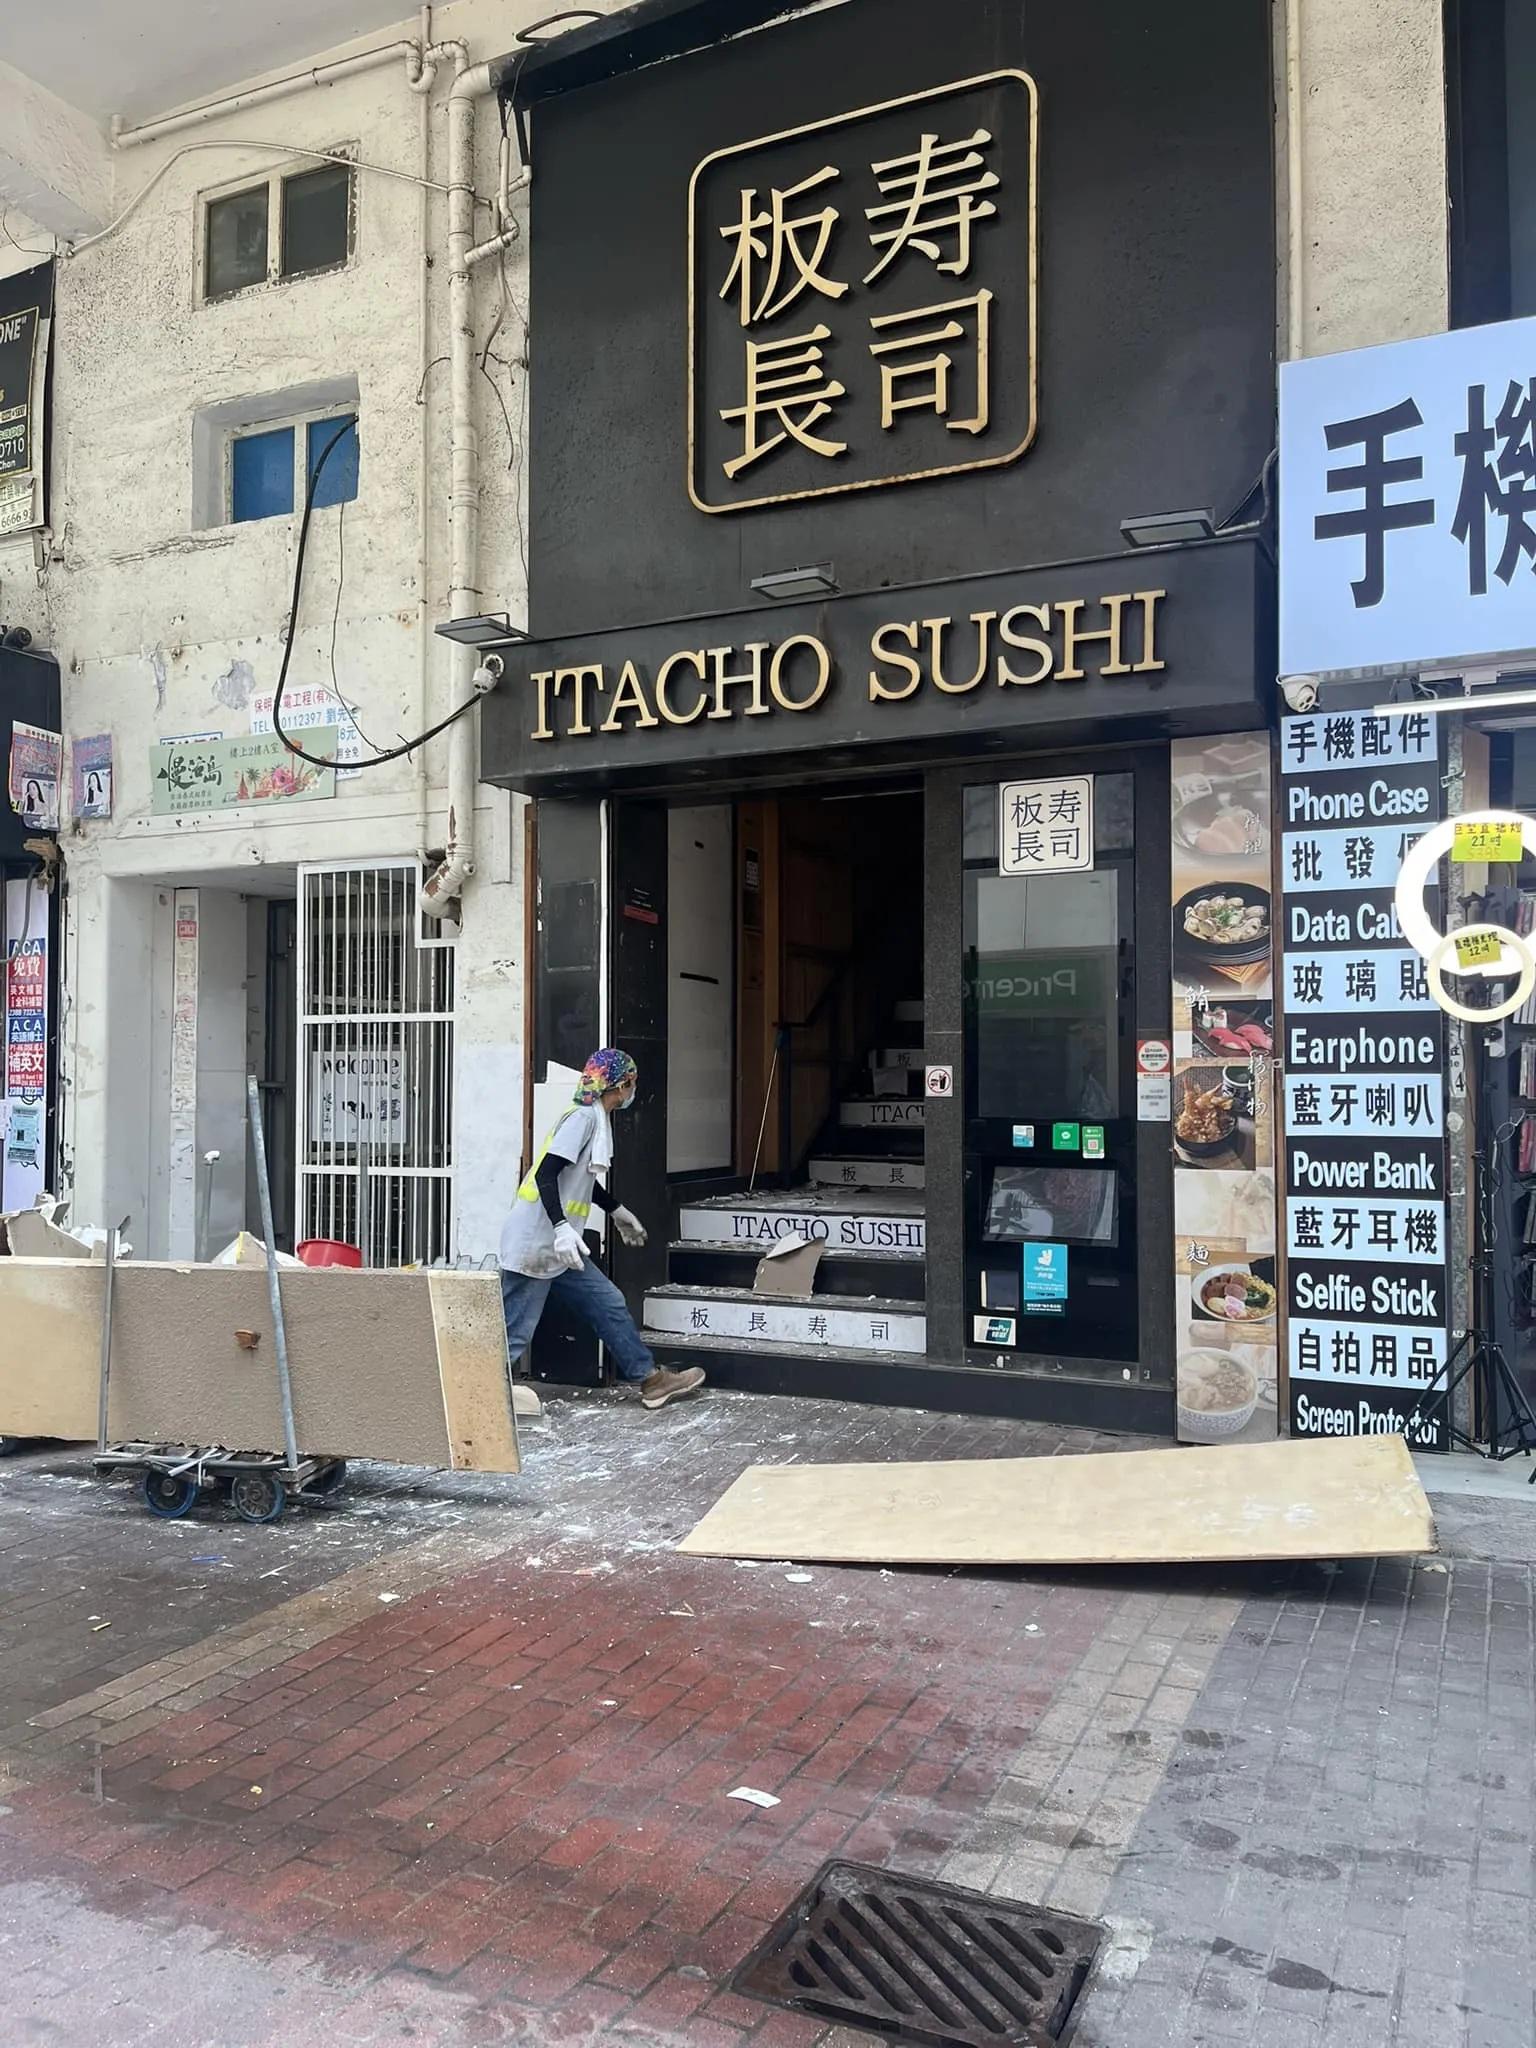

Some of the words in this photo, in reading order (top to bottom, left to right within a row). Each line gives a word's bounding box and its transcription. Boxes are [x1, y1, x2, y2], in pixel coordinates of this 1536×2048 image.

[530, 633, 832, 741] ITACHO
[868, 588, 1168, 703] SUSHI
[1287, 712, 1431, 764] 手機配件
[1288, 786, 1365, 822] Phone
[1369, 780, 1430, 817] Case
[1291, 906, 1351, 943] Data
[1356, 903, 1410, 941] Cab
[13, 957, 41, 977] 免費
[1293, 957, 1430, 1004] 玻璃貼
[12, 1019, 42, 1032] ACA
[323, 1054, 400, 1075] welcome
[1290, 1027, 1435, 1073] Earphone
[1292, 1083, 1435, 1127] 藍牙喇叭
[1293, 1150, 1369, 1188] Power
[1373, 1151, 1436, 1190] Bank
[840, 1220, 924, 1247] SUSHI
[1293, 1206, 1438, 1254] 藍牙耳機
[1295, 1272, 1367, 1313] Selfie
[1371, 1276, 1438, 1317] Stick
[1298, 1327, 1438, 1381] 自拍用品
[1296, 1394, 1354, 1435] Screen
